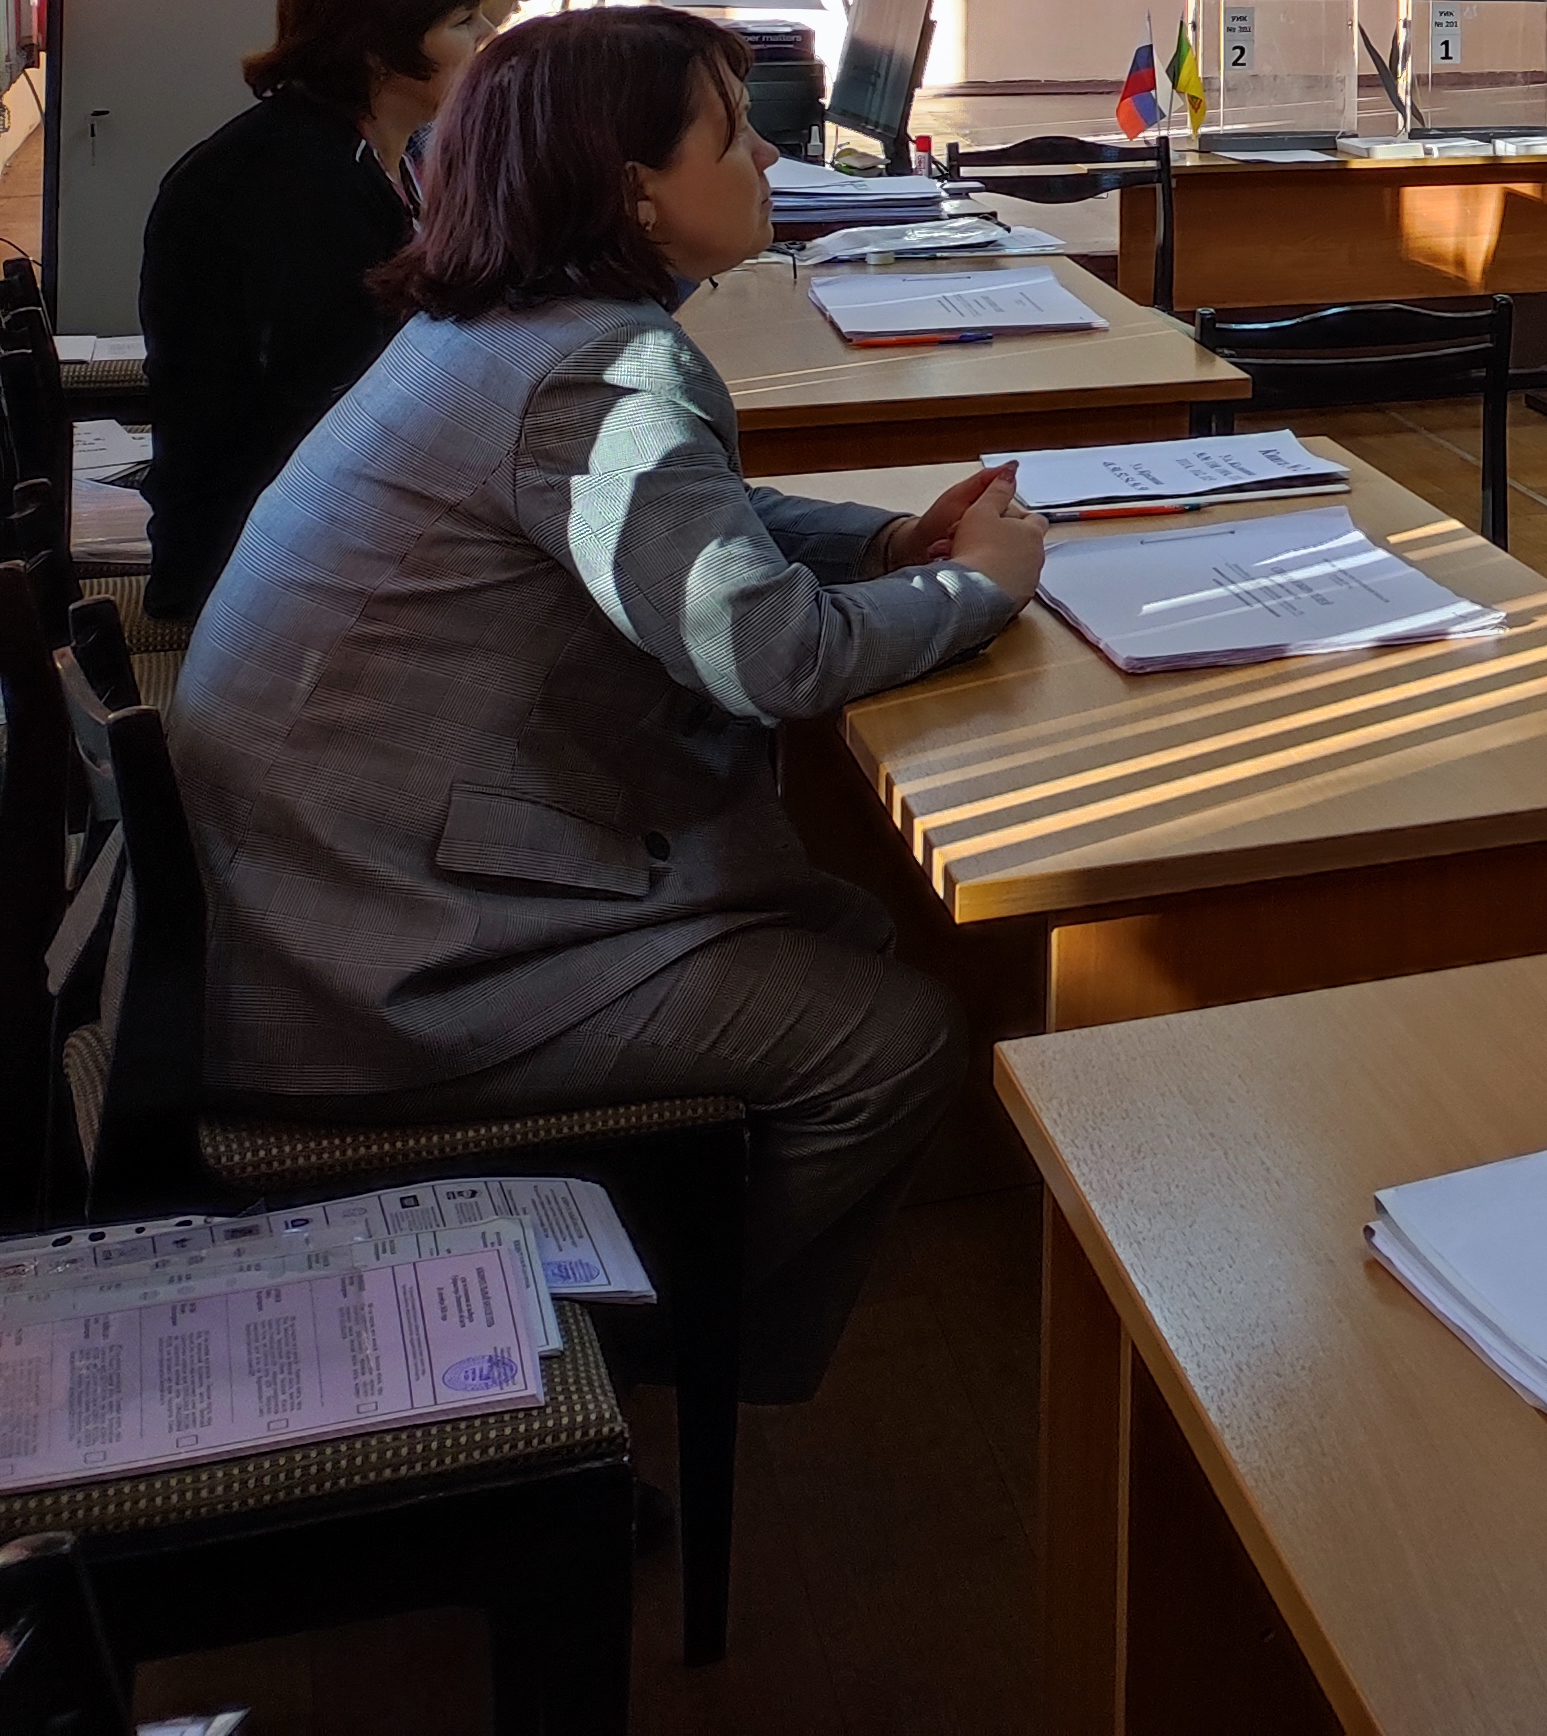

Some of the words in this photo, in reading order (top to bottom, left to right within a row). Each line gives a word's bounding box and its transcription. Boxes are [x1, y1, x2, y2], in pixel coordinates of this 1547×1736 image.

[762, 34, 803, 42] matters
[1231, 45, 1247, 67] 2
[1439, 39, 1454, 60] 1
